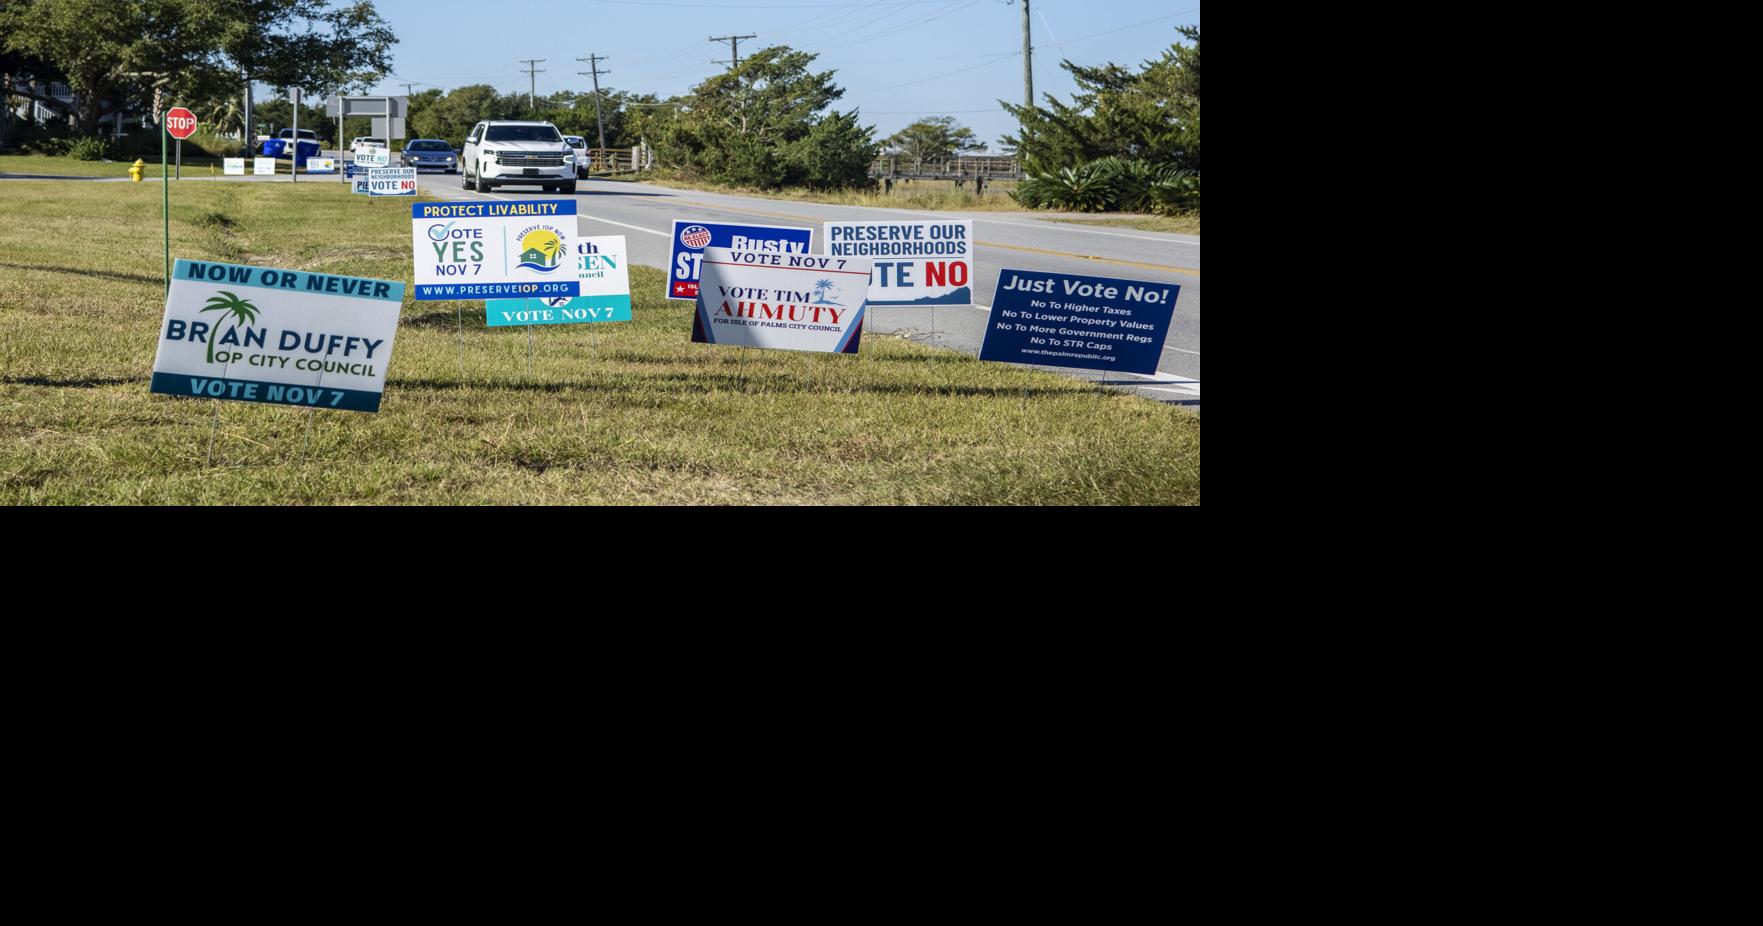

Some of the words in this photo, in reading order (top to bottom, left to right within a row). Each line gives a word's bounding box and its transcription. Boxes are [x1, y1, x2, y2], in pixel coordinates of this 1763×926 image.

[167, 117, 194, 129] STOP
[371, 181, 398, 190] VOTE
[401, 180, 415, 189] NO
[424, 205, 484, 216] PROTECT
[489, 204, 557, 215] LIVABILITY
[516, 225, 540, 241] PRESERVE
[831, 225, 924, 241] PRESERVE
[930, 224, 966, 239] OUR
[432, 241, 484, 263] YES
[731, 235, 805, 254] Rusty
[832, 241, 966, 256] NEIGHBORHOODS
[676, 252, 704, 280] ST
[731, 252, 781, 265] VOTE
[788, 256, 830, 269] NOV
[837, 260, 847, 270] 7
[436, 264, 467, 276] NOV
[473, 264, 481, 275] 7
[870, 262, 914, 287] TE
[925, 261, 968, 287] NO
[188, 263, 252, 283] NOW
[260, 270, 298, 289] OR
[306, 275, 390, 298] NEVER
[423, 283, 569, 295] WWW.PRESERVEIOP.ORG
[718, 286, 768, 300] VOTE
[774, 290, 810, 303] TIM
[1003, 275, 1055, 294] Just
[1064, 280, 1118, 299] Vote
[1125, 286, 1169, 304] No!
[502, 310, 554, 323] VOTE
[562, 308, 599, 320] NOV
[605, 307, 614, 318] 7
[714, 301, 846, 324] AHMUTY
[1064, 303, 1100, 313] Higher
[1103, 306, 1132, 316] Taxes
[1035, 313, 1068, 322] Lower
[1070, 317, 1116, 328] Property
[1120, 321, 1154, 331] Values
[1029, 325, 1056, 334] More
[1058, 328, 1123, 340] Government
[1127, 334, 1153, 344] Regs
[279, 330, 384, 360] DUFFY
[1063, 339, 1083, 348] STR
[1086, 342, 1112, 351] Caps
[1021, 348, 1115, 362] www.thepalmrepublic.org
[249, 354, 291, 369] CITY
[295, 358, 376, 377] COUNCIL
[190, 378, 259, 400] VOTE
[266, 385, 325, 405] NOV
[331, 391, 345, 406] 7
